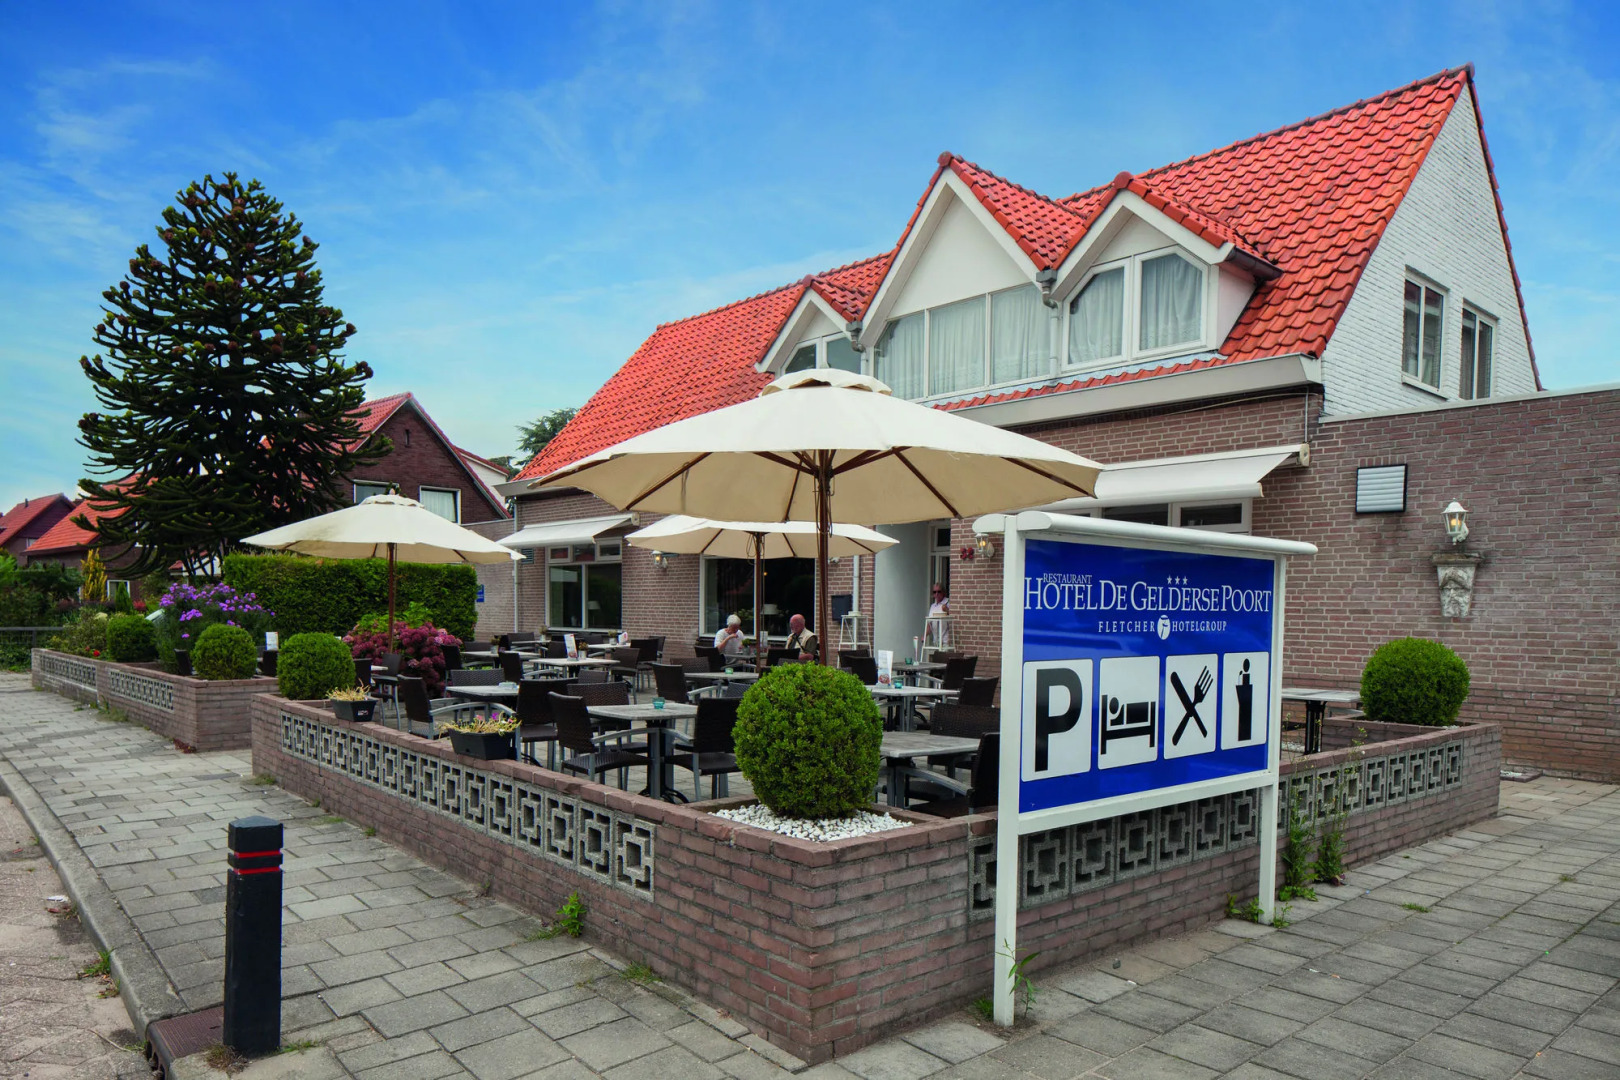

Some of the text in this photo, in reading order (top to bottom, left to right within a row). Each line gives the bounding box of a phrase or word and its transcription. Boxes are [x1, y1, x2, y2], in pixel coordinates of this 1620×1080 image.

[1043, 573, 1092, 584] RESTAURANT
[1024, 577, 1271, 612] HOTEL DE GELDERSE POORT
[1098, 620, 1227, 632] FLETCHER HOTELGROUP
[1035, 668, 1083, 773] P
